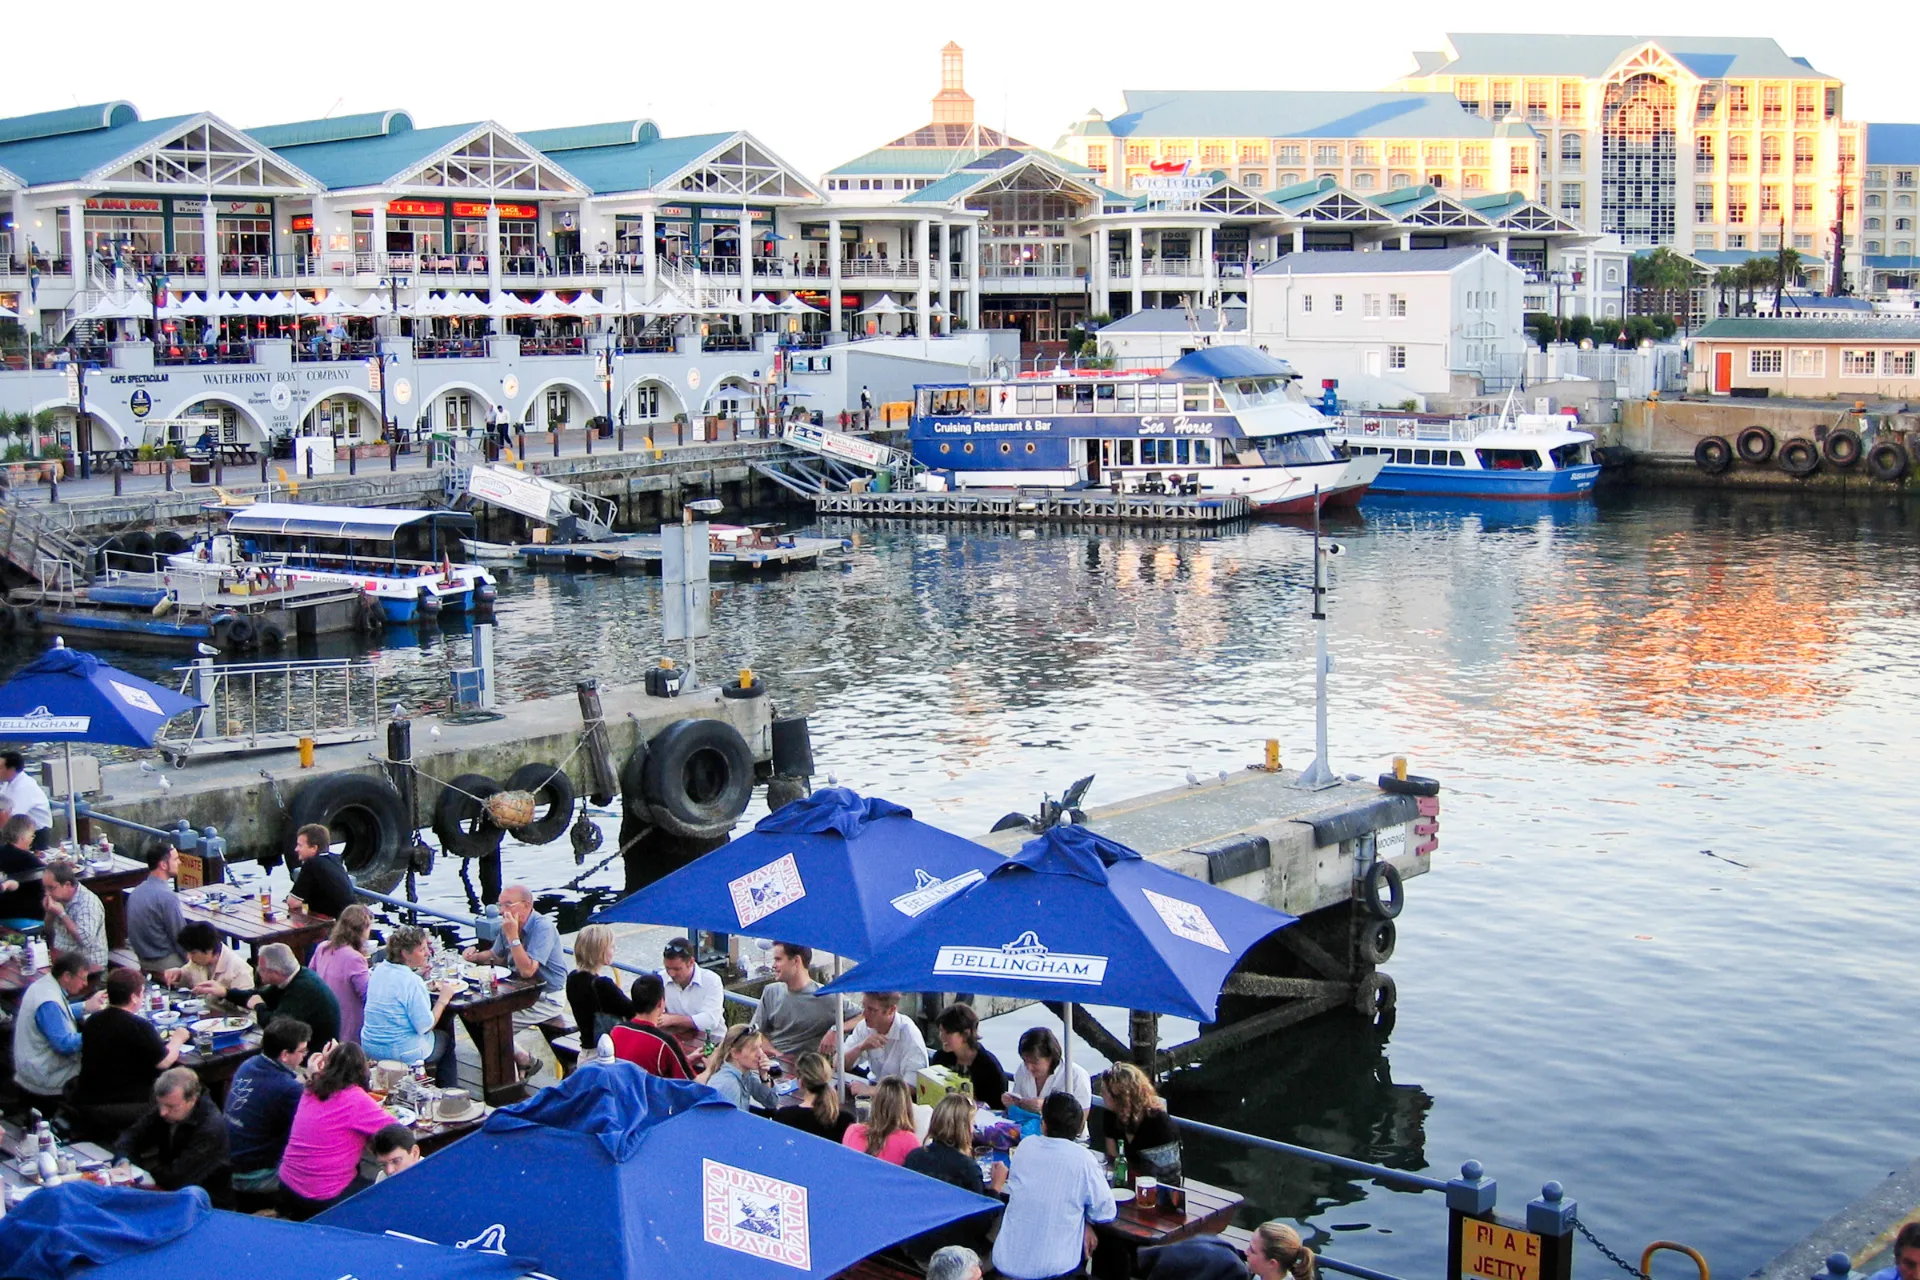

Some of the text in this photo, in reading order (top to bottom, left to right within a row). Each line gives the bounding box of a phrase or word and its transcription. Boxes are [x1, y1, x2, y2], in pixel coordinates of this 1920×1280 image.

[1135, 178, 1212, 188] VICTORIA
[1149, 190, 1200, 198] WHARF
[129, 200, 160, 211] SPUR
[110, 375, 126, 384] CAPE
[203, 372, 272, 385] WATERFRONT
[307, 369, 351, 382] COMPANY
[934, 420, 1052, 435] Cruising Restaurant & Bar
[1138, 416, 1213, 435] Sea Horse
[951, 953, 1091, 976] BELLINGHAM
[1473, 1255, 1527, 1280] JETTY
